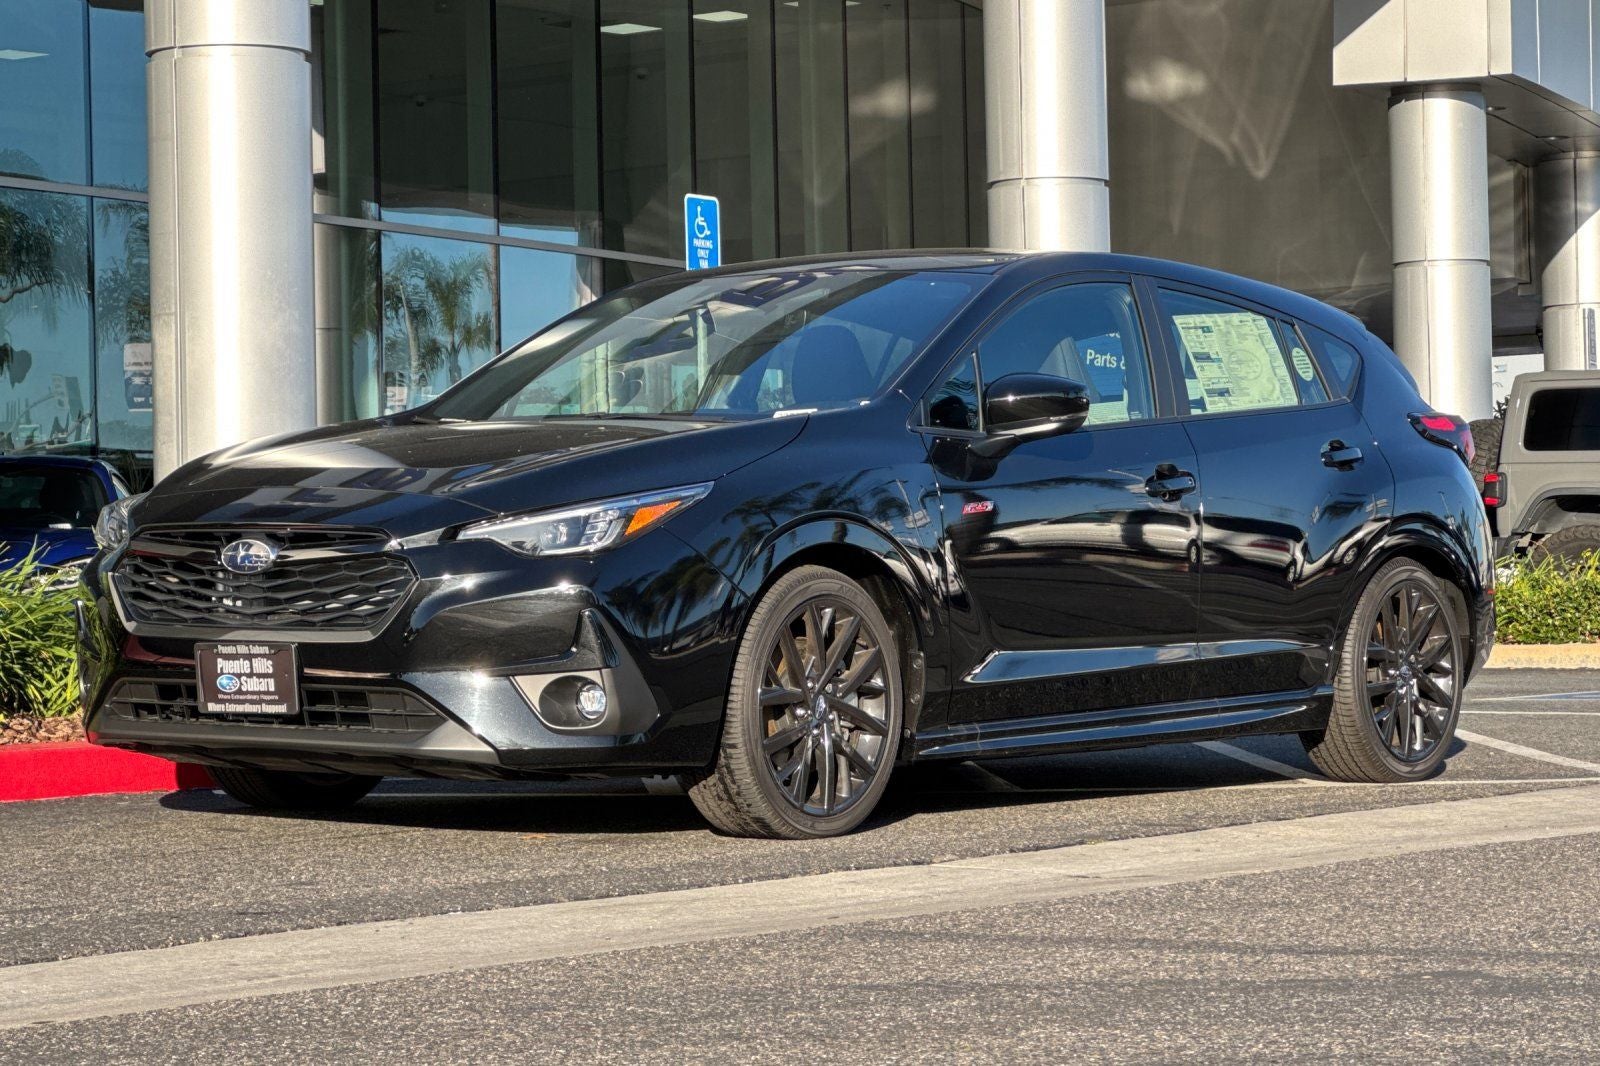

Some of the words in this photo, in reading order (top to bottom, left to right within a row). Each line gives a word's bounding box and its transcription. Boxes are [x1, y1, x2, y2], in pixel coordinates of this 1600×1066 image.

[693, 238, 713, 249] PARKING
[697, 248, 709, 258] ONLY
[699, 259, 709, 268] VAN
[1086, 349, 1117, 368] Parts
[217, 645, 236, 654] Puente
[236, 645, 250, 654] Hills
[249, 645, 269, 654] Subaru
[217, 657, 250, 673] Puente
[252, 657, 273, 673] Hills
[241, 676, 275, 691] Subaru
[207, 702, 226, 712] Where
[226, 702, 261, 713] Extraordinary
